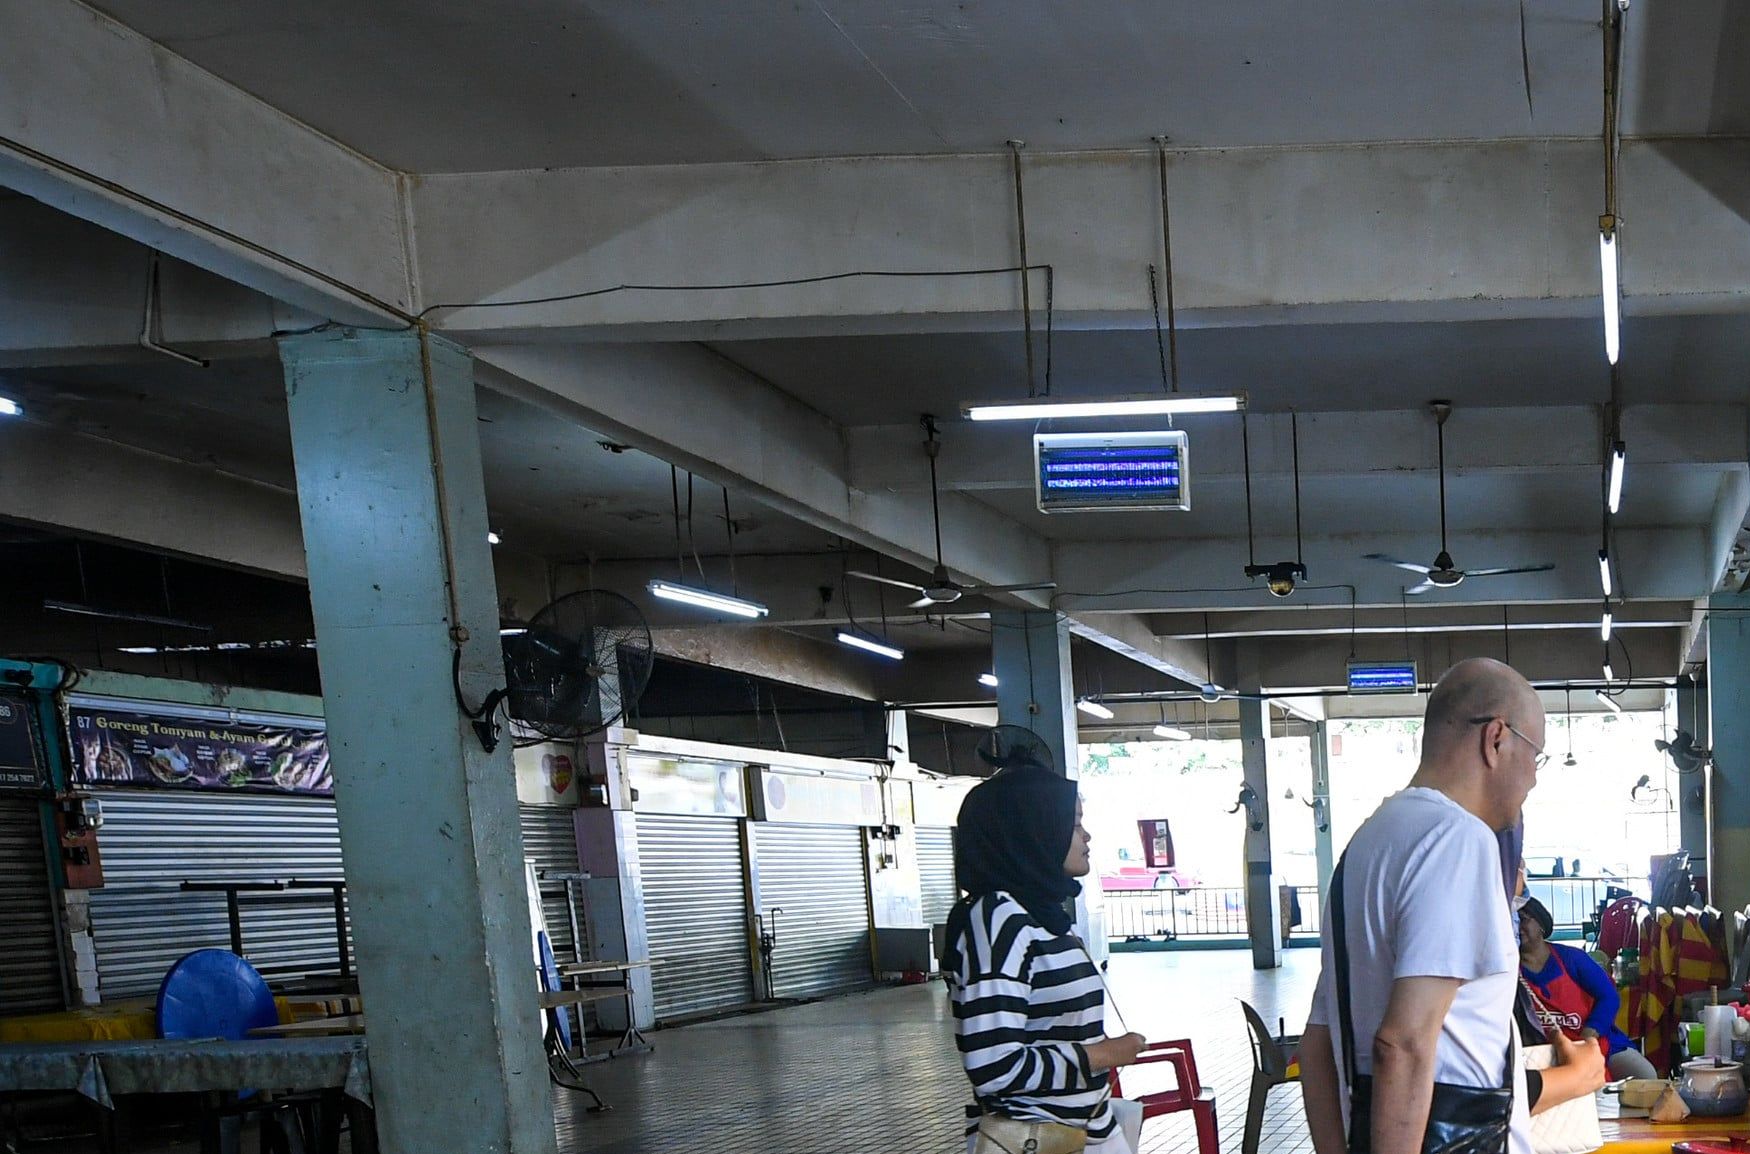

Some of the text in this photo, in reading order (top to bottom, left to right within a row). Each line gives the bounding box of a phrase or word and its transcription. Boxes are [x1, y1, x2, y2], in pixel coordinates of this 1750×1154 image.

[77, 715, 91, 729] 87
[96, 717, 149, 735] Goreng
[150, 722, 206, 740] Tomyam
